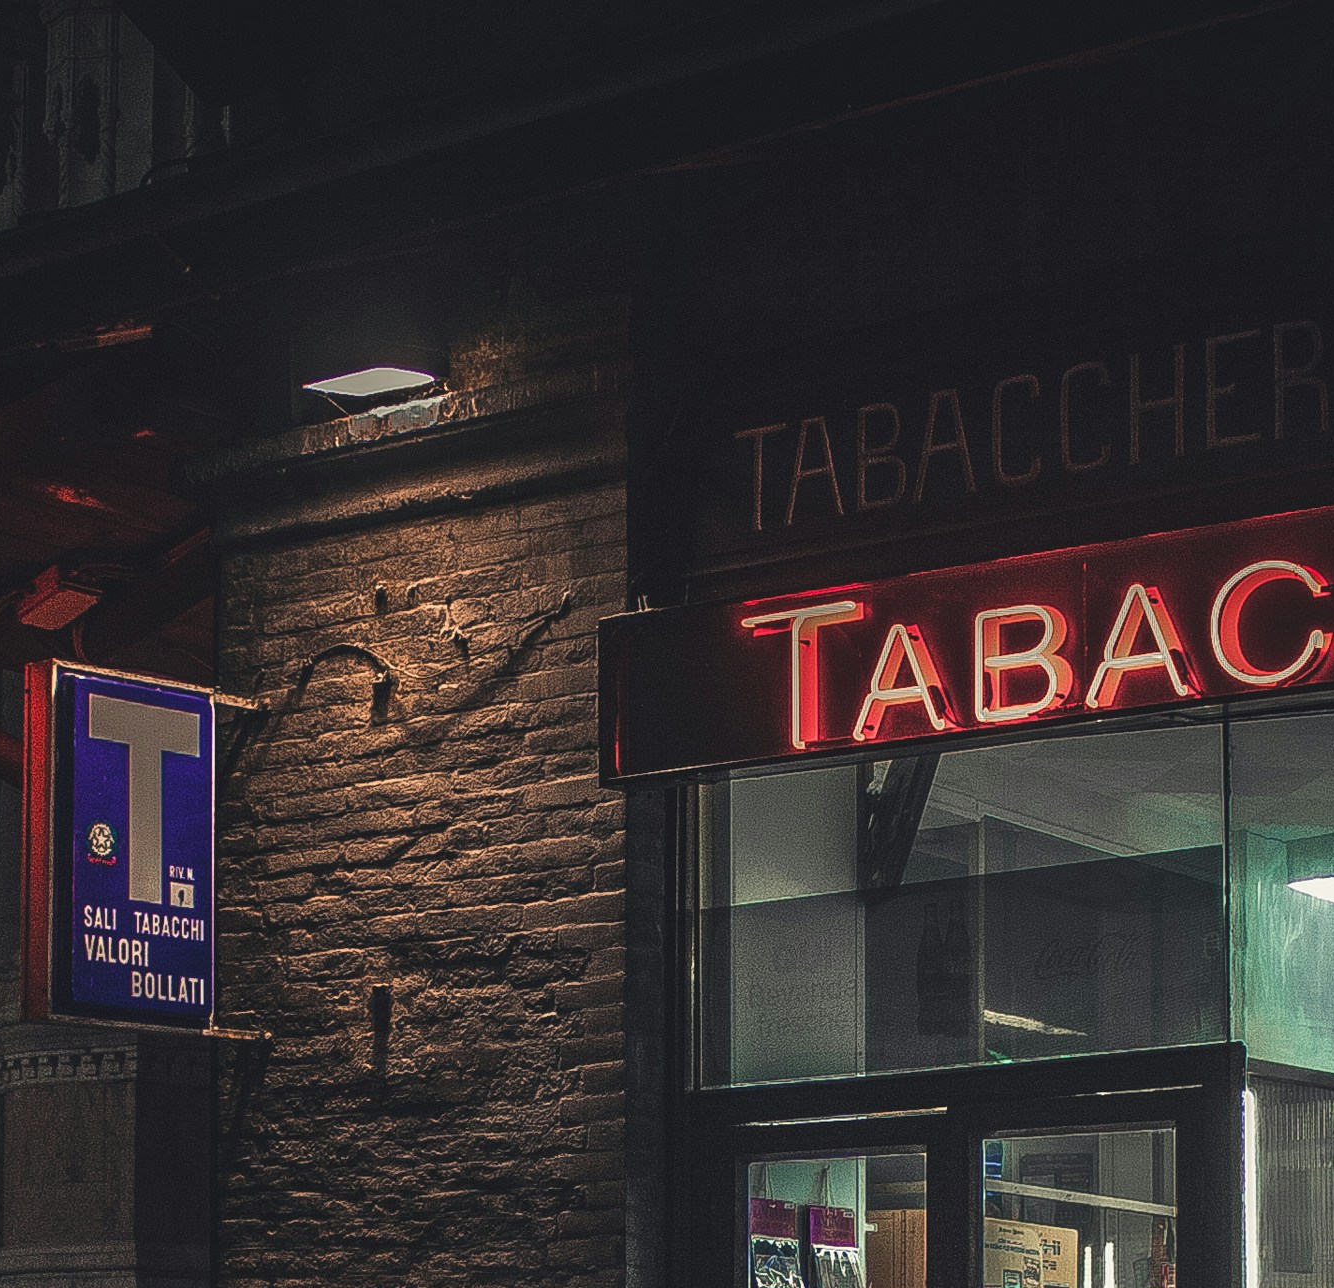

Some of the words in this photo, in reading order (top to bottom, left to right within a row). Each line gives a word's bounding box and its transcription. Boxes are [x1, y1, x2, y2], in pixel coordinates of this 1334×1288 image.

[88, 691, 201, 906] T
[83, 904, 117, 932] SALI
[133, 910, 205, 943] TABACCHI
[84, 933, 149, 968] VALORI
[131, 970, 205, 1006] BOLLATI
